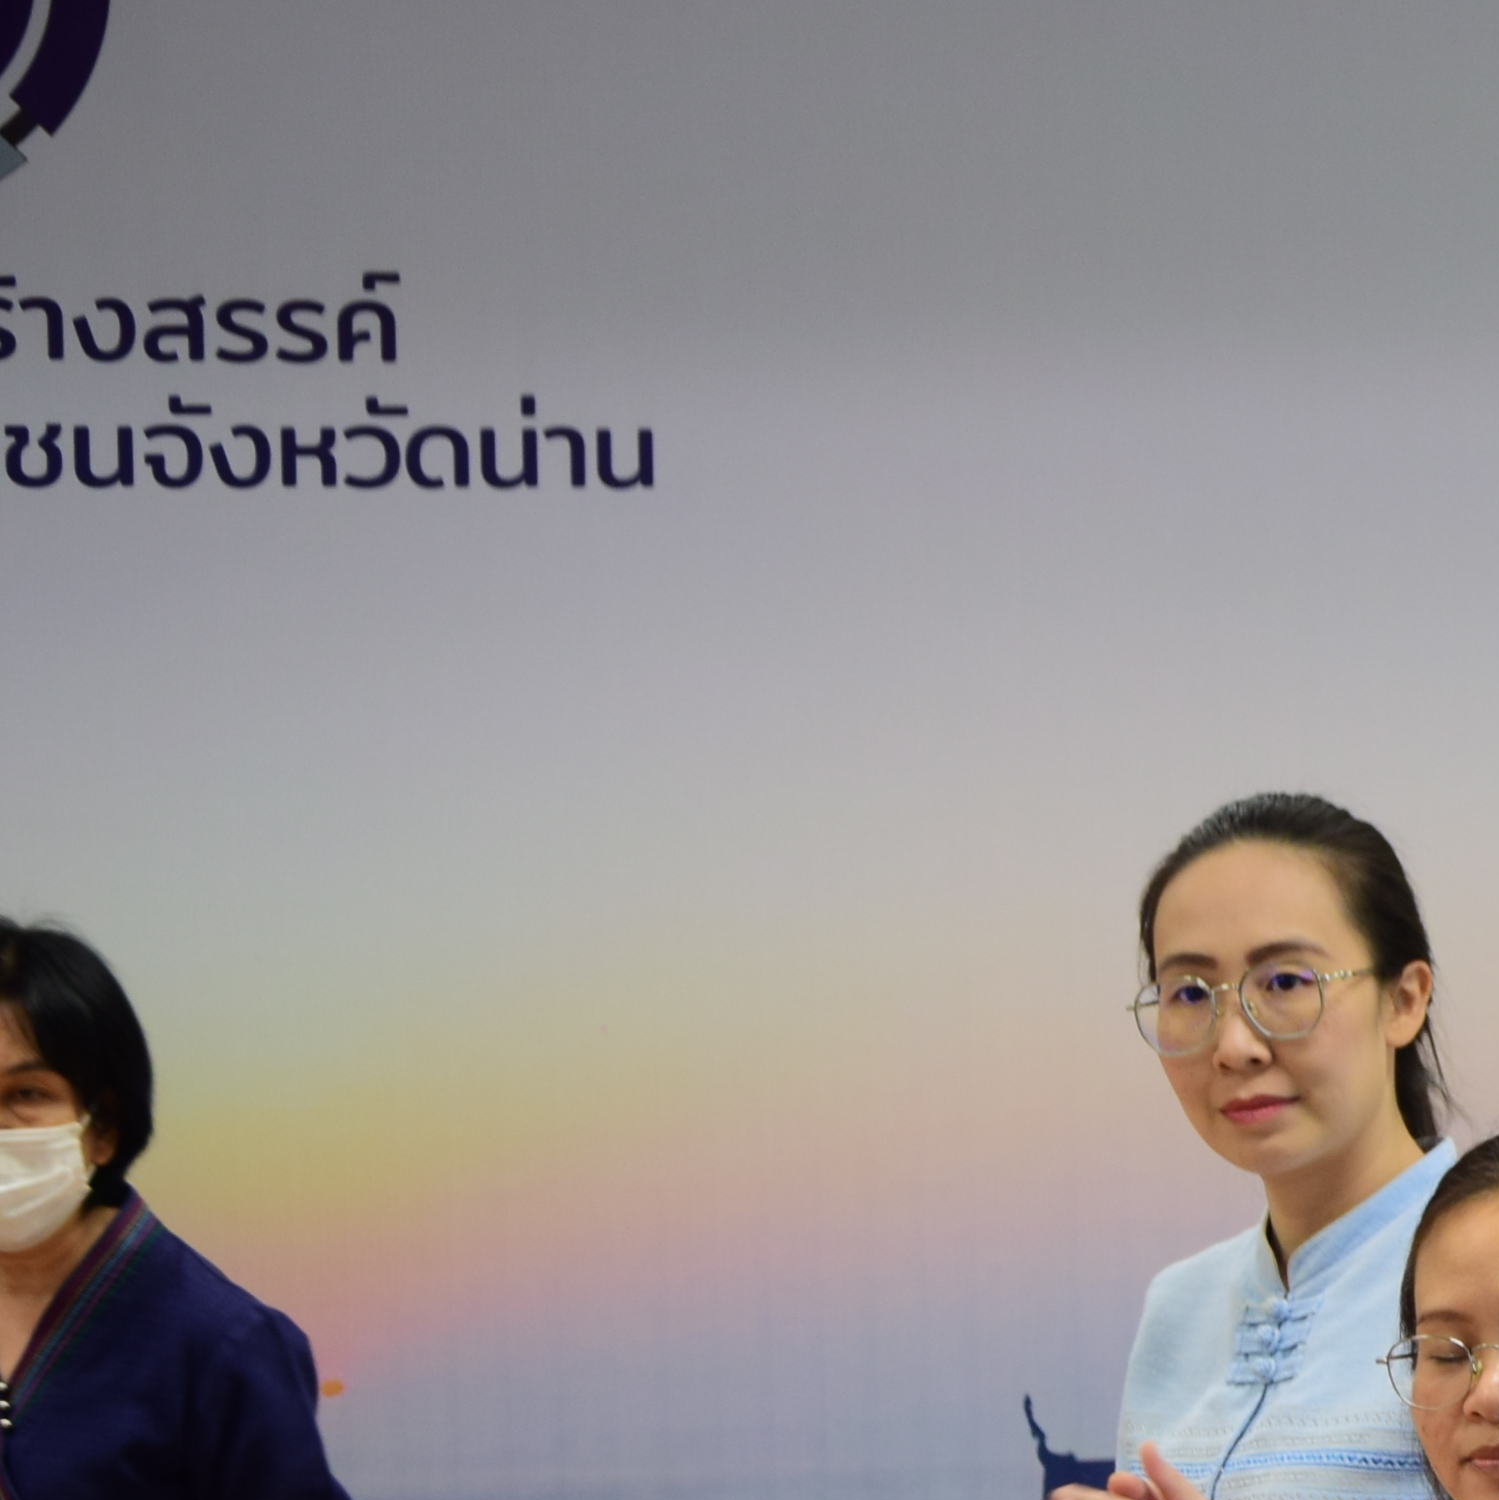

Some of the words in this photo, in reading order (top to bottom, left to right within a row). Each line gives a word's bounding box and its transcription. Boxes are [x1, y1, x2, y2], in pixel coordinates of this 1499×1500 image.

[4, 394, 654, 488] ชนจังหวัดน่าน
